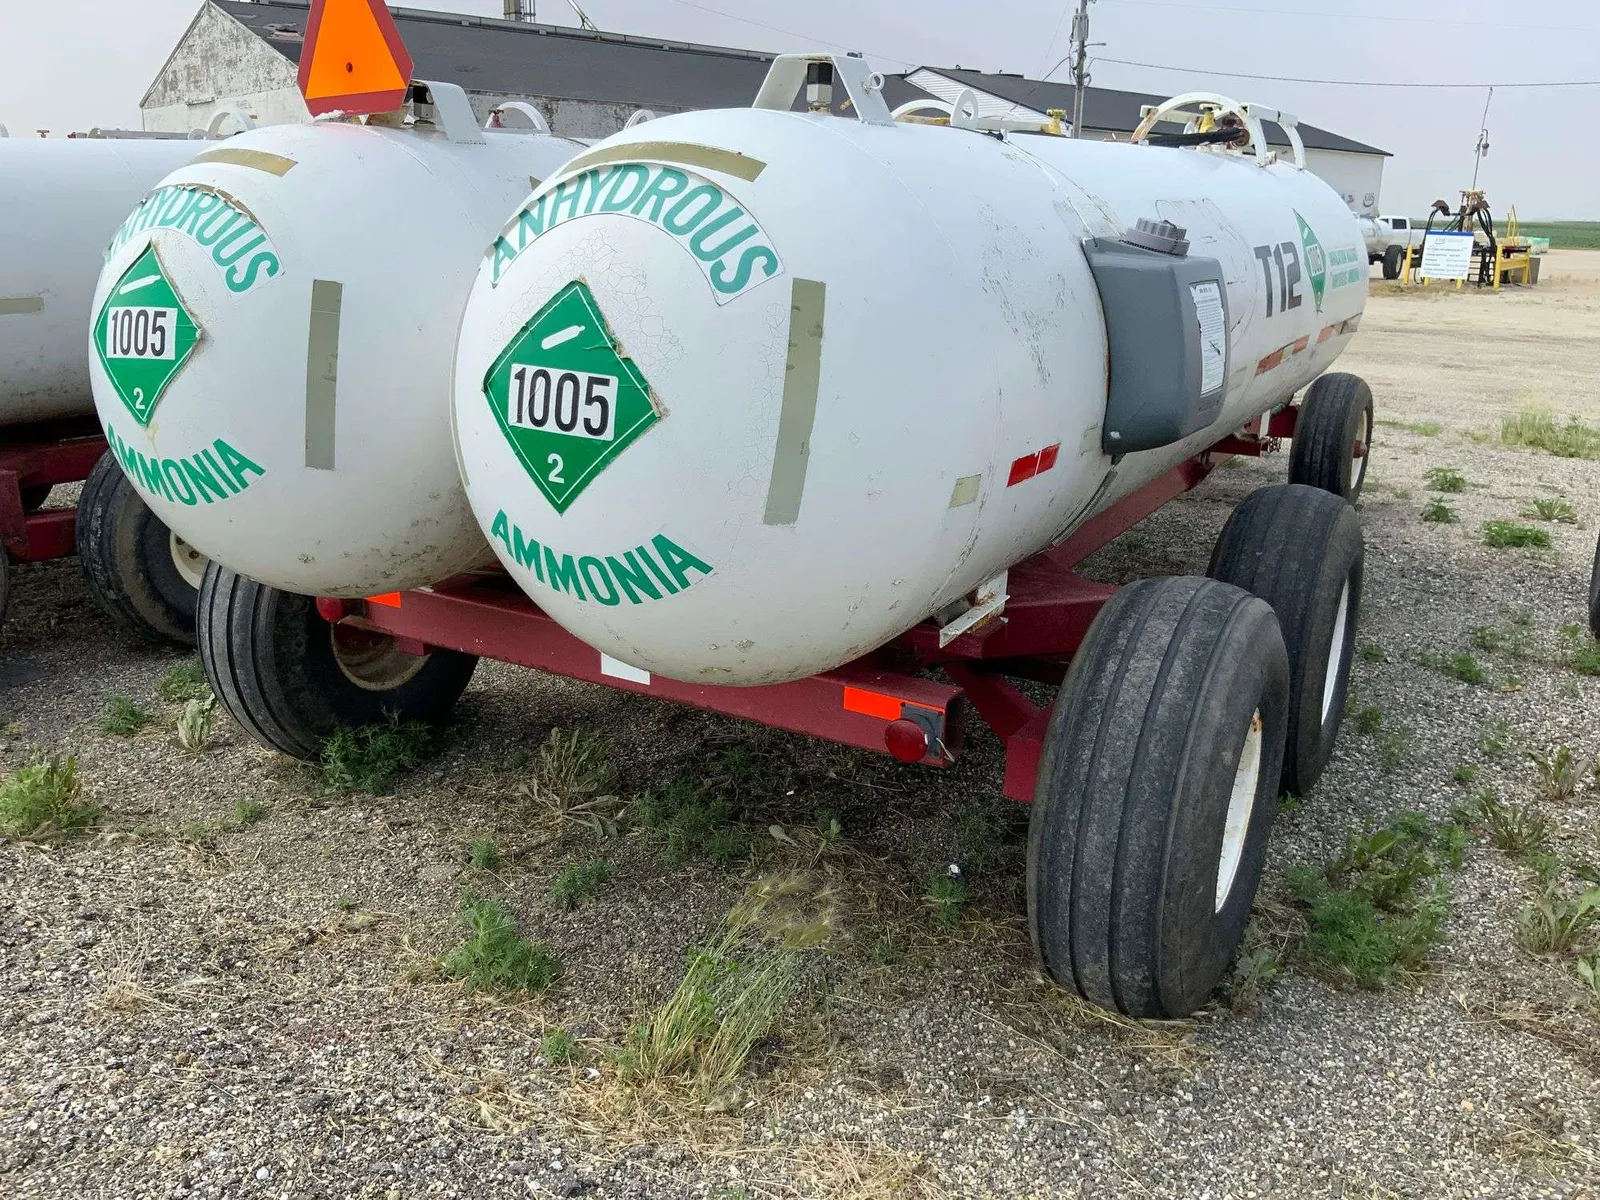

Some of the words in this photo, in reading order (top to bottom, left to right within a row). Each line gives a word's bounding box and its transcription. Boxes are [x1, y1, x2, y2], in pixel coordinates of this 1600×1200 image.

[491, 163, 778, 295] ANHYDROUS
[1253, 241, 1302, 318] T12
[111, 309, 167, 356] 1005
[133, 387, 145, 410] 2
[513, 366, 612, 437] 1005
[108, 422, 266, 506] AMMONIA
[546, 453, 565, 484] 2
[491, 509, 714, 606] AMMONIA
